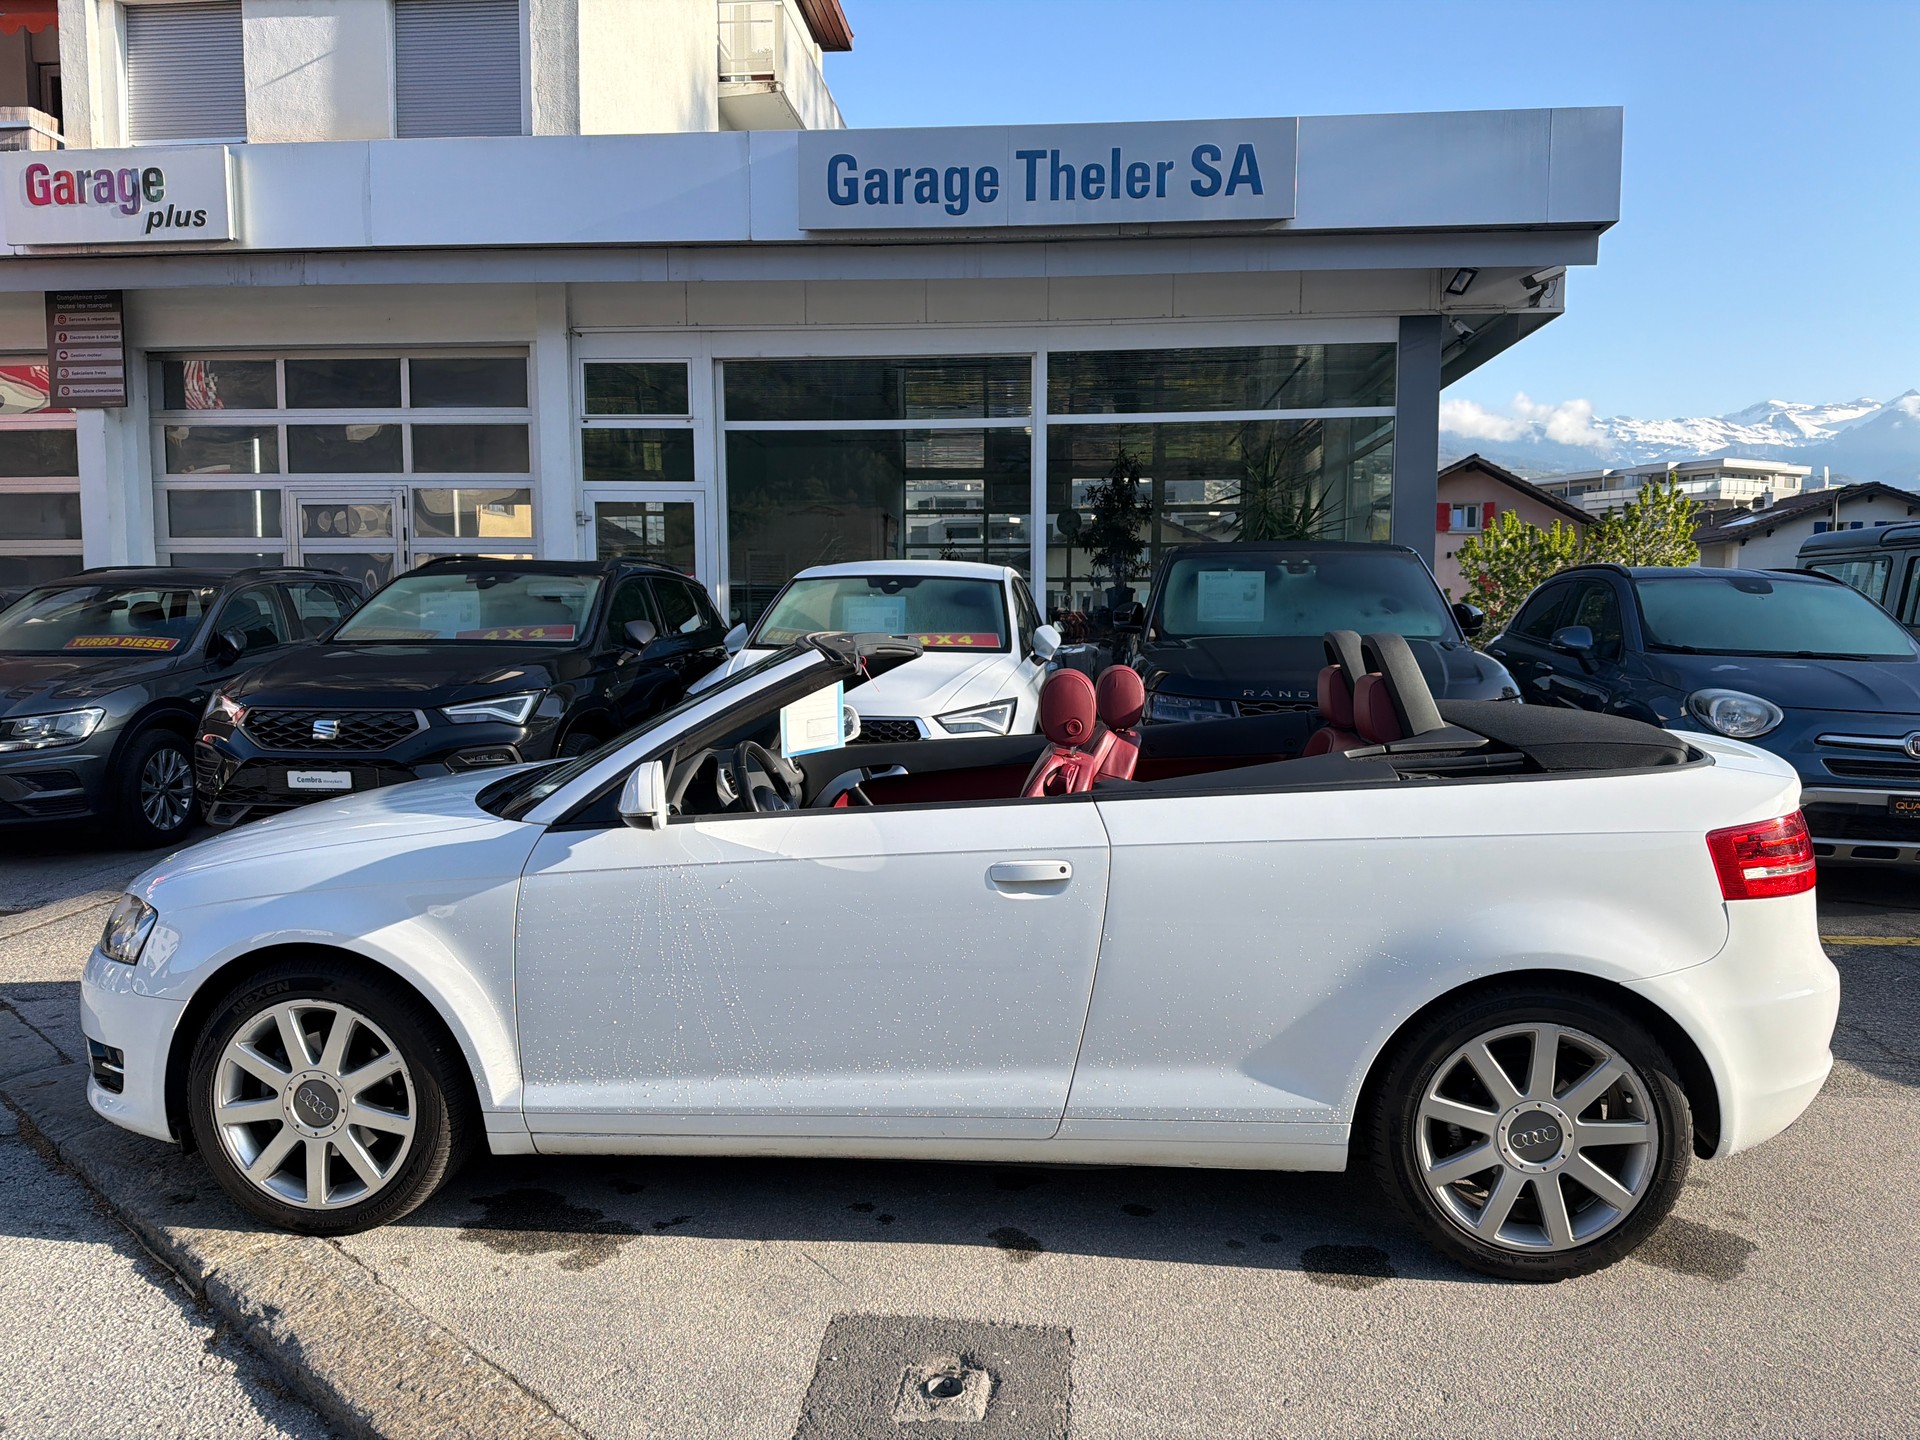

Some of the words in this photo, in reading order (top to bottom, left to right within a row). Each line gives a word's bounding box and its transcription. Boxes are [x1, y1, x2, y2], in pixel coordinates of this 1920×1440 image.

[25, 163, 166, 215] Garage
[826, 152, 1000, 216] Garage
[1015, 147, 1175, 202] Theler
[1190, 142, 1264, 198] SA
[145, 204, 208, 234] plus
[73, 638, 118, 647] TURBO
[120, 638, 170, 649] DIESEL
[1243, 689, 1311, 698] RANG
[1895, 801, 1920, 810] QUA
[231, 980, 290, 1014] NEXEN
